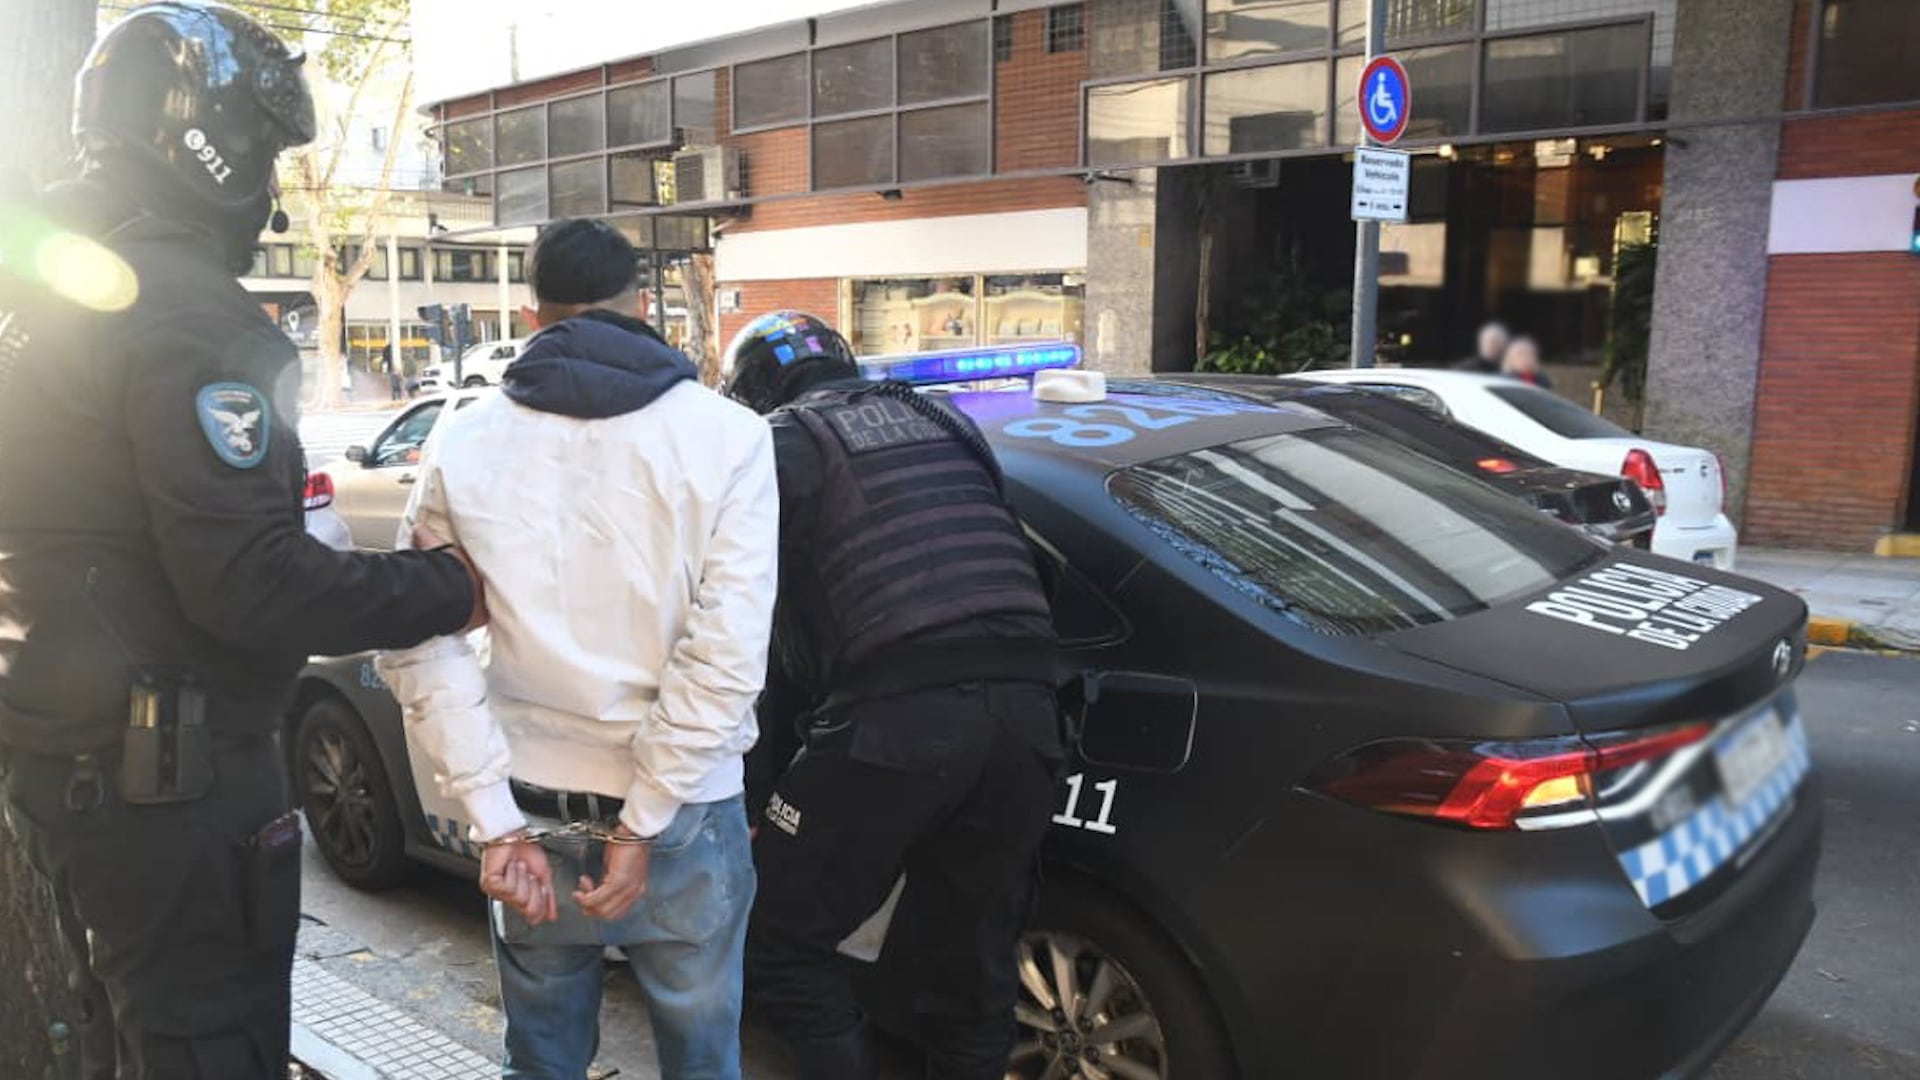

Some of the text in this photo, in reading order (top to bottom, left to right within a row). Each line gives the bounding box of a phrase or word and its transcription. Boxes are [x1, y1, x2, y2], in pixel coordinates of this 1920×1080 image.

[197, 145, 233, 184] 911
[851, 430, 878, 449] DE
[879, 424, 908, 443] LA
[1650, 608, 1722, 633] LA
[1626, 621, 1700, 650] DE
